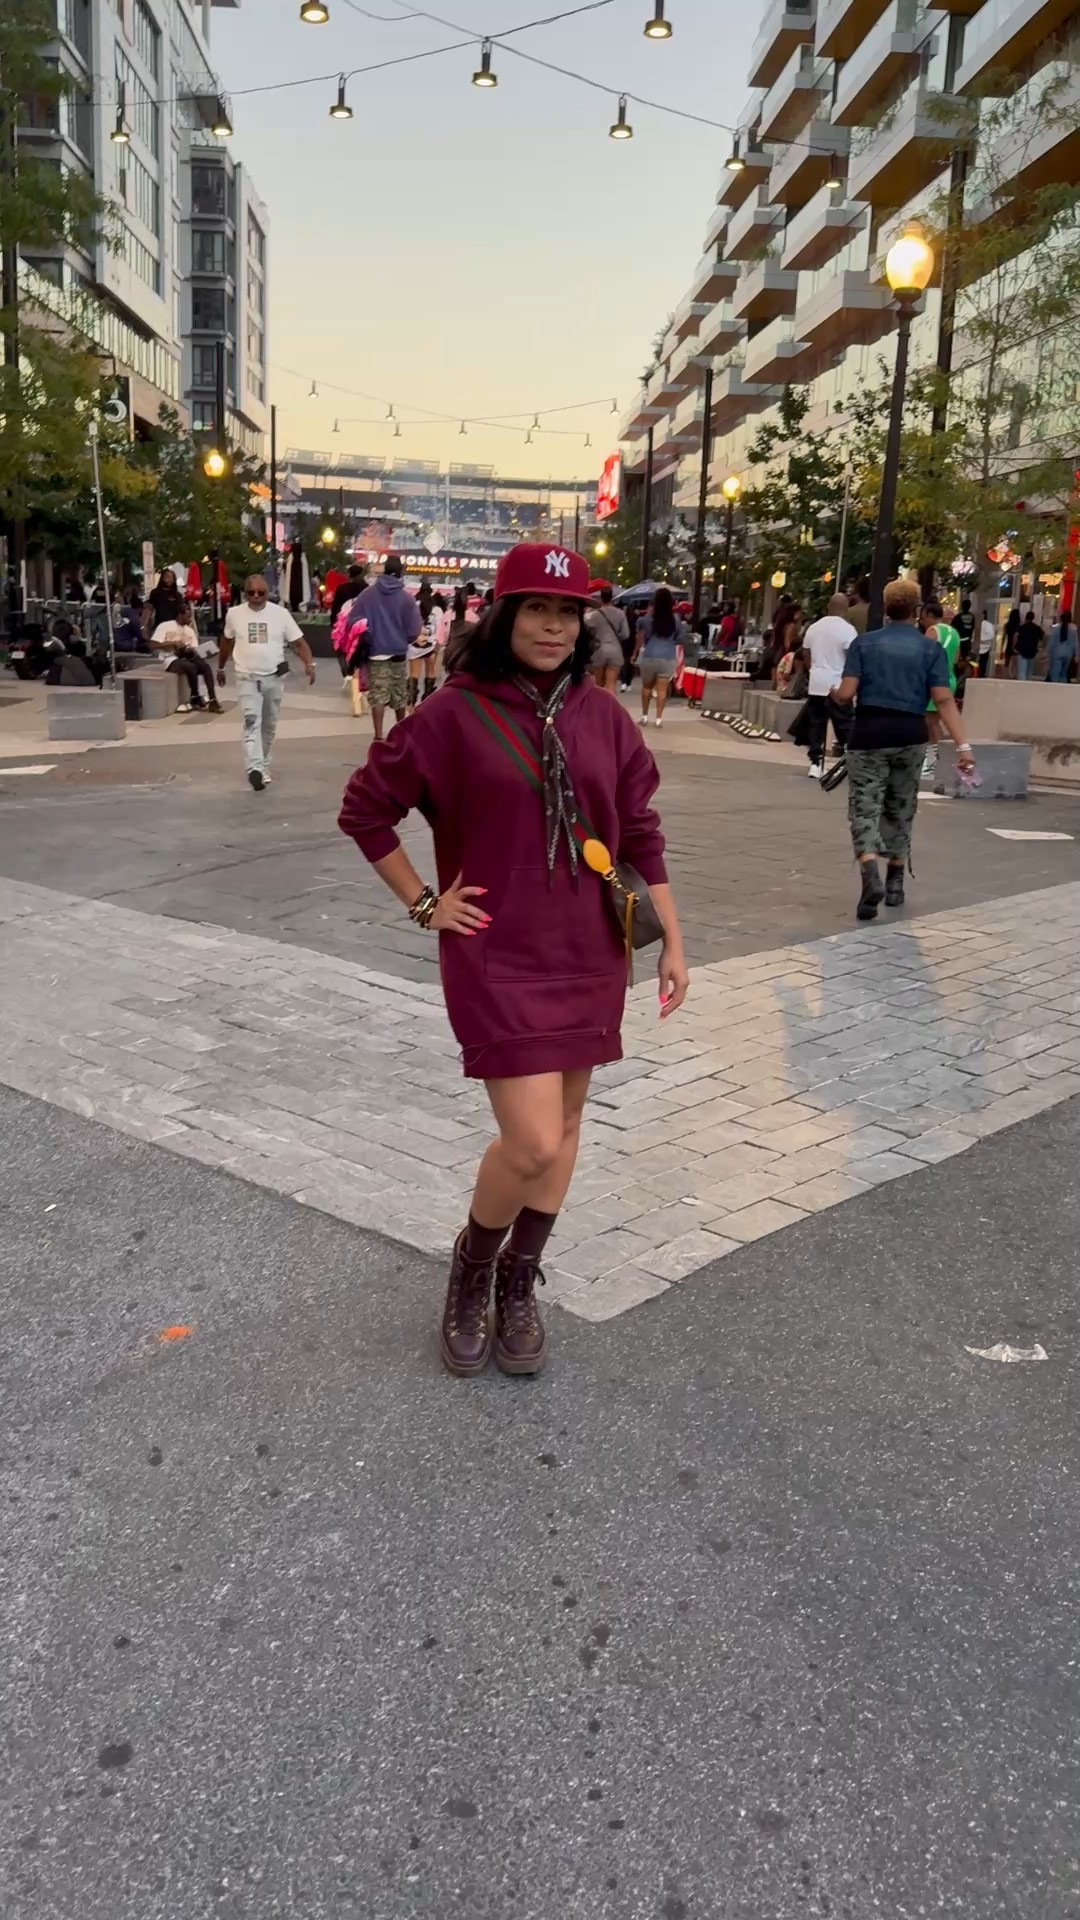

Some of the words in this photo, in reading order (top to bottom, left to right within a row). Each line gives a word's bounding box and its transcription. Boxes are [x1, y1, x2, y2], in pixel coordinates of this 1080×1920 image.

[368, 551, 457, 567] NAIONALS
[460, 558, 498, 568] PARK
[544, 549, 570, 577] NY
